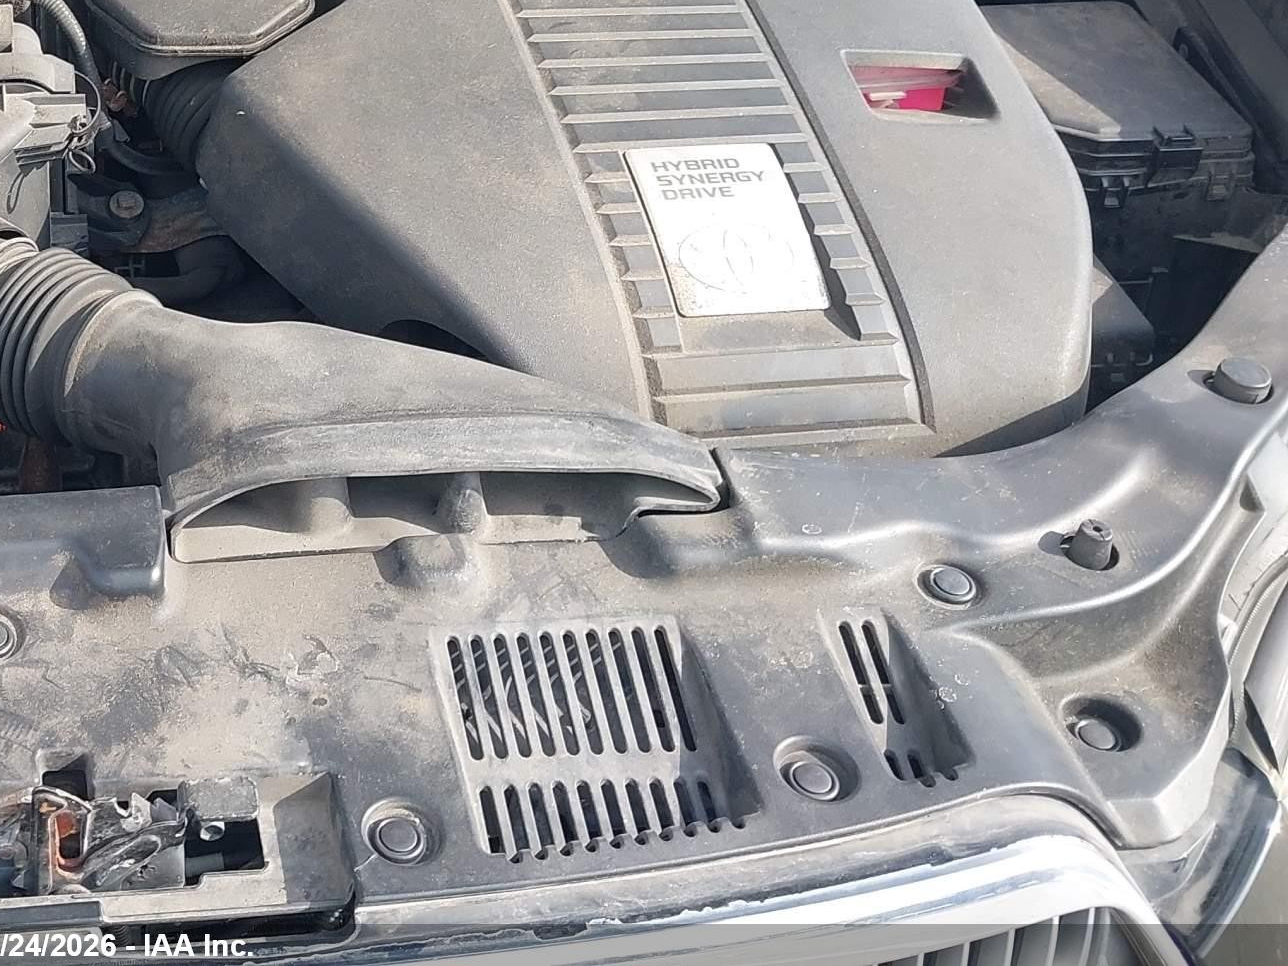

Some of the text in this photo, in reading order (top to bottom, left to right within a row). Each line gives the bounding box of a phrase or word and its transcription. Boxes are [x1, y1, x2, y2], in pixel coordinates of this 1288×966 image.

[650, 158, 740, 172] HYBRID
[655, 170, 765, 186] SYNERGY
[661, 187, 735, 200] DRIVE
